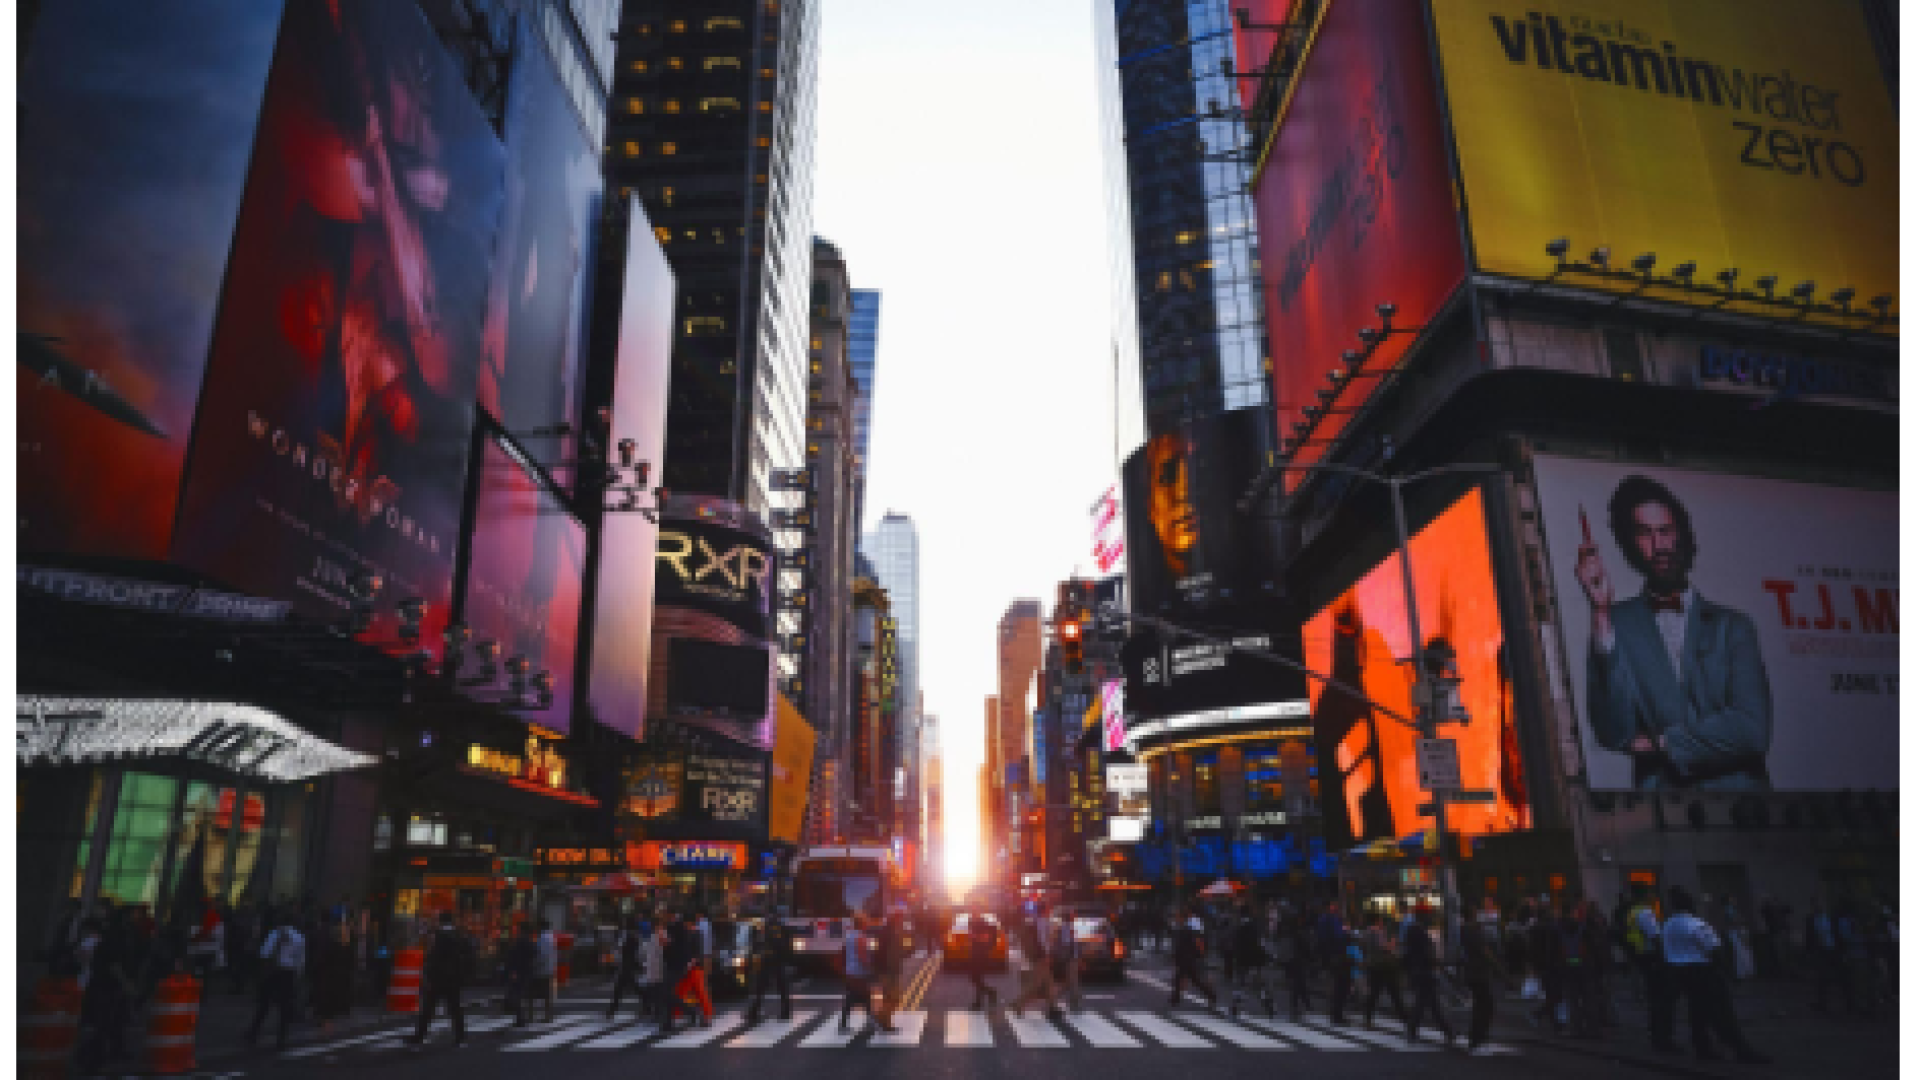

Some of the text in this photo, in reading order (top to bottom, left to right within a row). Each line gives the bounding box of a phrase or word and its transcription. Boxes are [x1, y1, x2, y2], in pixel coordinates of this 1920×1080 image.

[1732, 119, 1866, 187] zero
[656, 530, 771, 590] RXR
[1762, 578, 1900, 635] T.J. M
